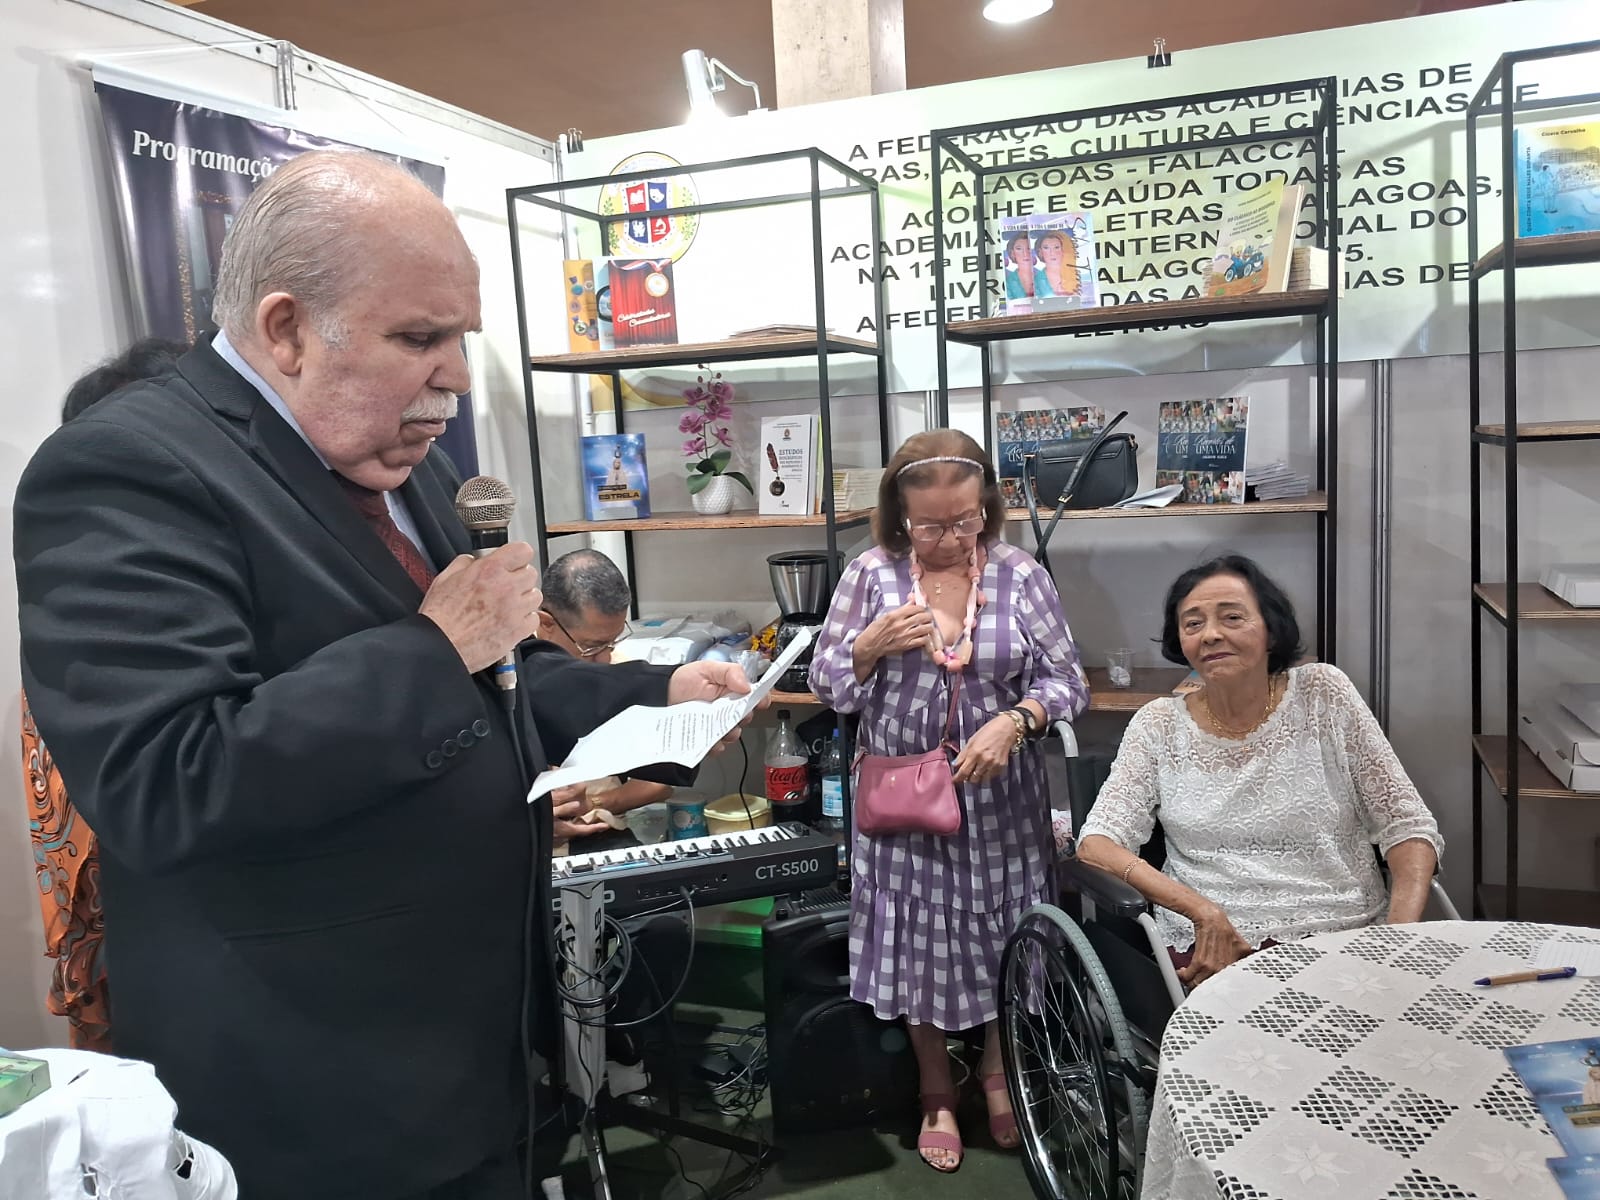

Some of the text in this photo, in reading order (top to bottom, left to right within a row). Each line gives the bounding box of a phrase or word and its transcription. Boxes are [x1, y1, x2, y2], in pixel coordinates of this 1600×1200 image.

[848, 144, 868, 162] A
[1419, 63, 1473, 88] DE
[901, 197, 1036, 231] ACOLHE
[1048, 194, 1067, 213] E
[1079, 176, 1203, 209] SAÚDA
[1353, 156, 1406, 180] AS
[948, 162, 1114, 200] ALAGOAS
[830, 228, 1002, 263] ACADEMIA
[858, 265, 900, 285] NA
[1410, 206, 1467, 230] DO
[856, 316, 876, 334] A
[1419, 262, 1470, 284] DE
[778, 448, 803, 456] ESTUDOS
[598, 491, 640, 500] ESTRELA
[755, 858, 819, 880] CT-S500
